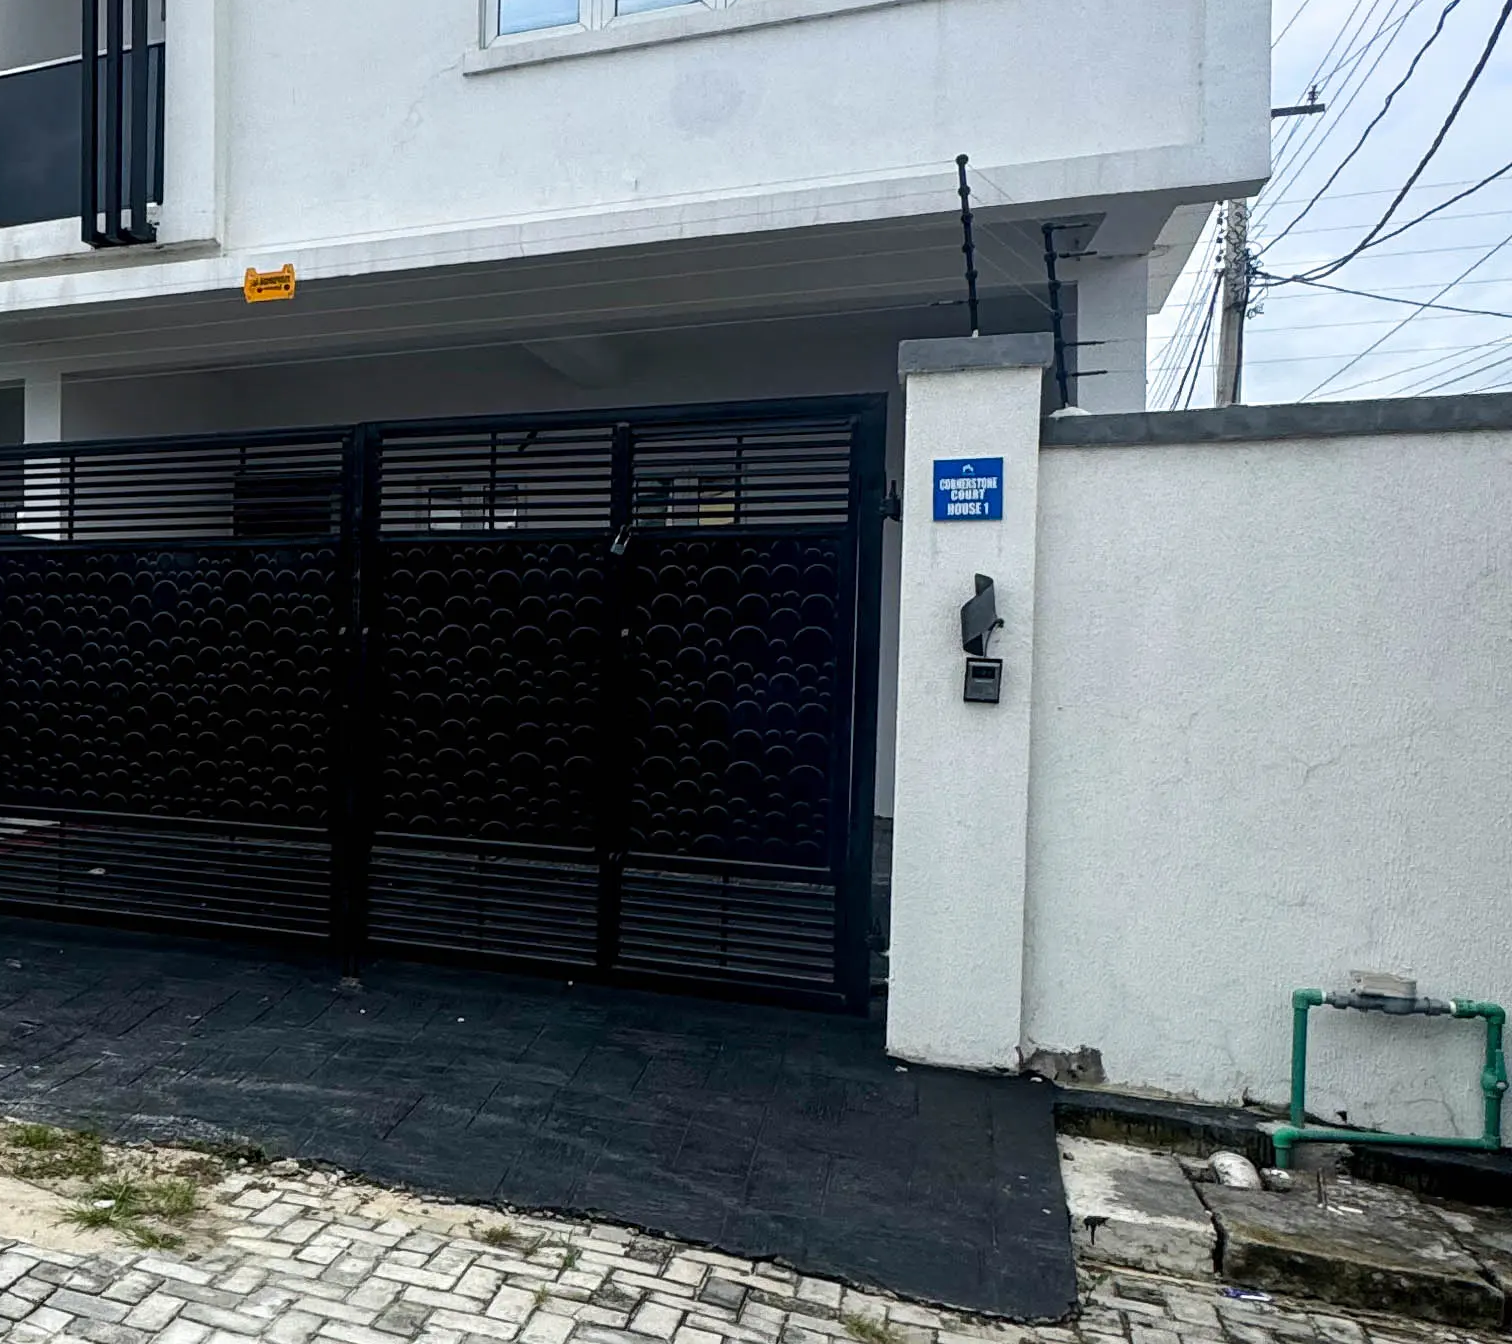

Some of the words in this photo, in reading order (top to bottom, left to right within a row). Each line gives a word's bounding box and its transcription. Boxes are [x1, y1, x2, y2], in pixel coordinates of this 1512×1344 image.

[939, 477, 998, 491] CORNERSTONE
[950, 488, 986, 501] COURT
[947, 503, 982, 516] HOUSE
[983, 503, 989, 515] 1
